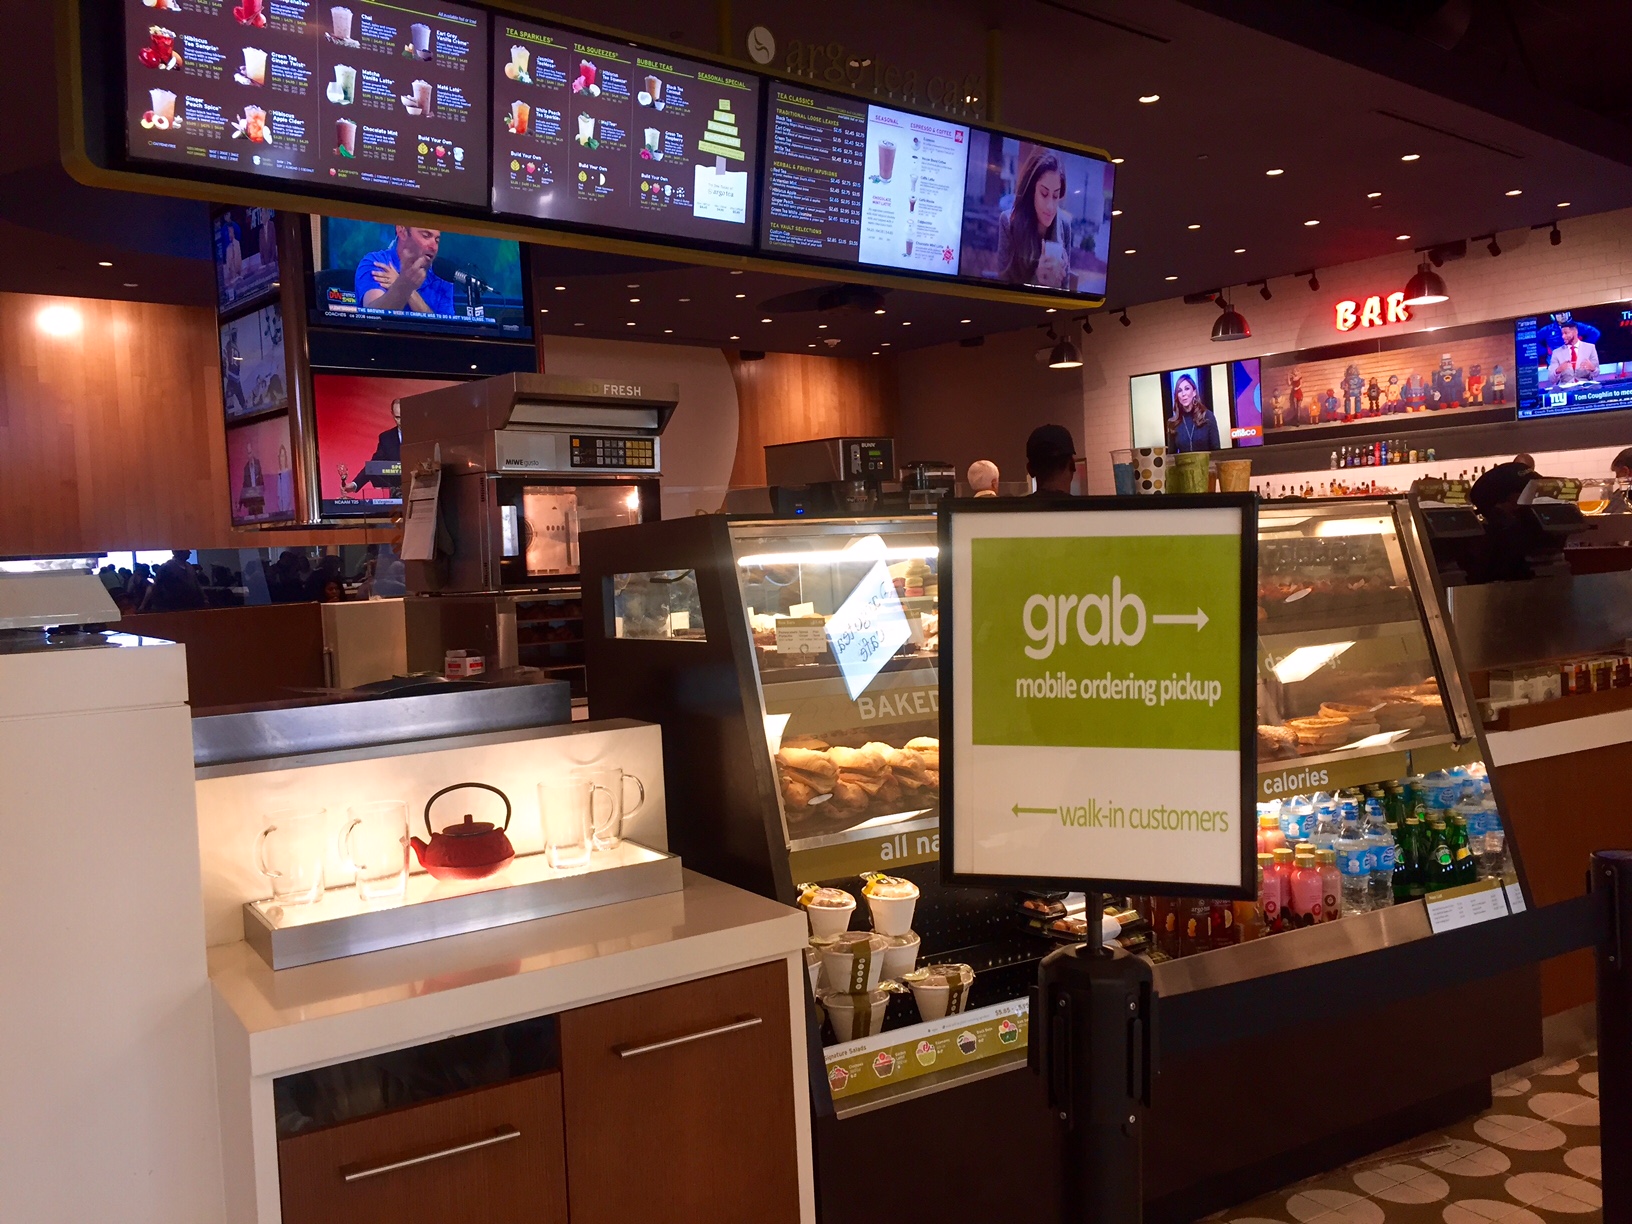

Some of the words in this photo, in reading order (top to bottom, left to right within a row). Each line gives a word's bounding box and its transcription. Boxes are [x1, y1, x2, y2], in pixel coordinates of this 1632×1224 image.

[520, 30, 551, 43] SPARKLES
[271, 52, 287, 60] Green
[574, 43, 585, 51] TEA
[587, 46, 616, 58] SQUEEZES
[637, 58, 658, 68] BUBBLE
[659, 63, 673, 71] TEAS
[698, 72, 724, 83] SEASONAL
[725, 78, 746, 87] SPECIAL
[789, 95, 814, 105] CLASSICS
[776, 108, 806, 120] TRADITIONAL
[822, 118, 839, 126] LEAVES
[875, 115, 898, 124] SEASONAL
[363, 126, 386, 134] Chocolate
[910, 122, 932, 132] ESPRESSO
[774, 161, 791, 169] HERBAL
[814, 169, 838, 177] INFUSIONS
[795, 226, 822, 234] SELECTIONS
[1336, 292, 1409, 332] BAR
[603, 384, 642, 397] FRESH
[1588, 391, 1613, 400] Coughlin
[1022, 575, 1147, 660] grab
[1016, 672, 1077, 699] mobile
[1080, 672, 1156, 706] ordering
[1160, 672, 1222, 707] pickup
[1263, 768, 1329, 794] calories
[1060, 798, 1125, 828] walk-in
[1129, 804, 1229, 832] customers
[880, 834, 908, 860] all
[849, 1045, 867, 1054] Salads
